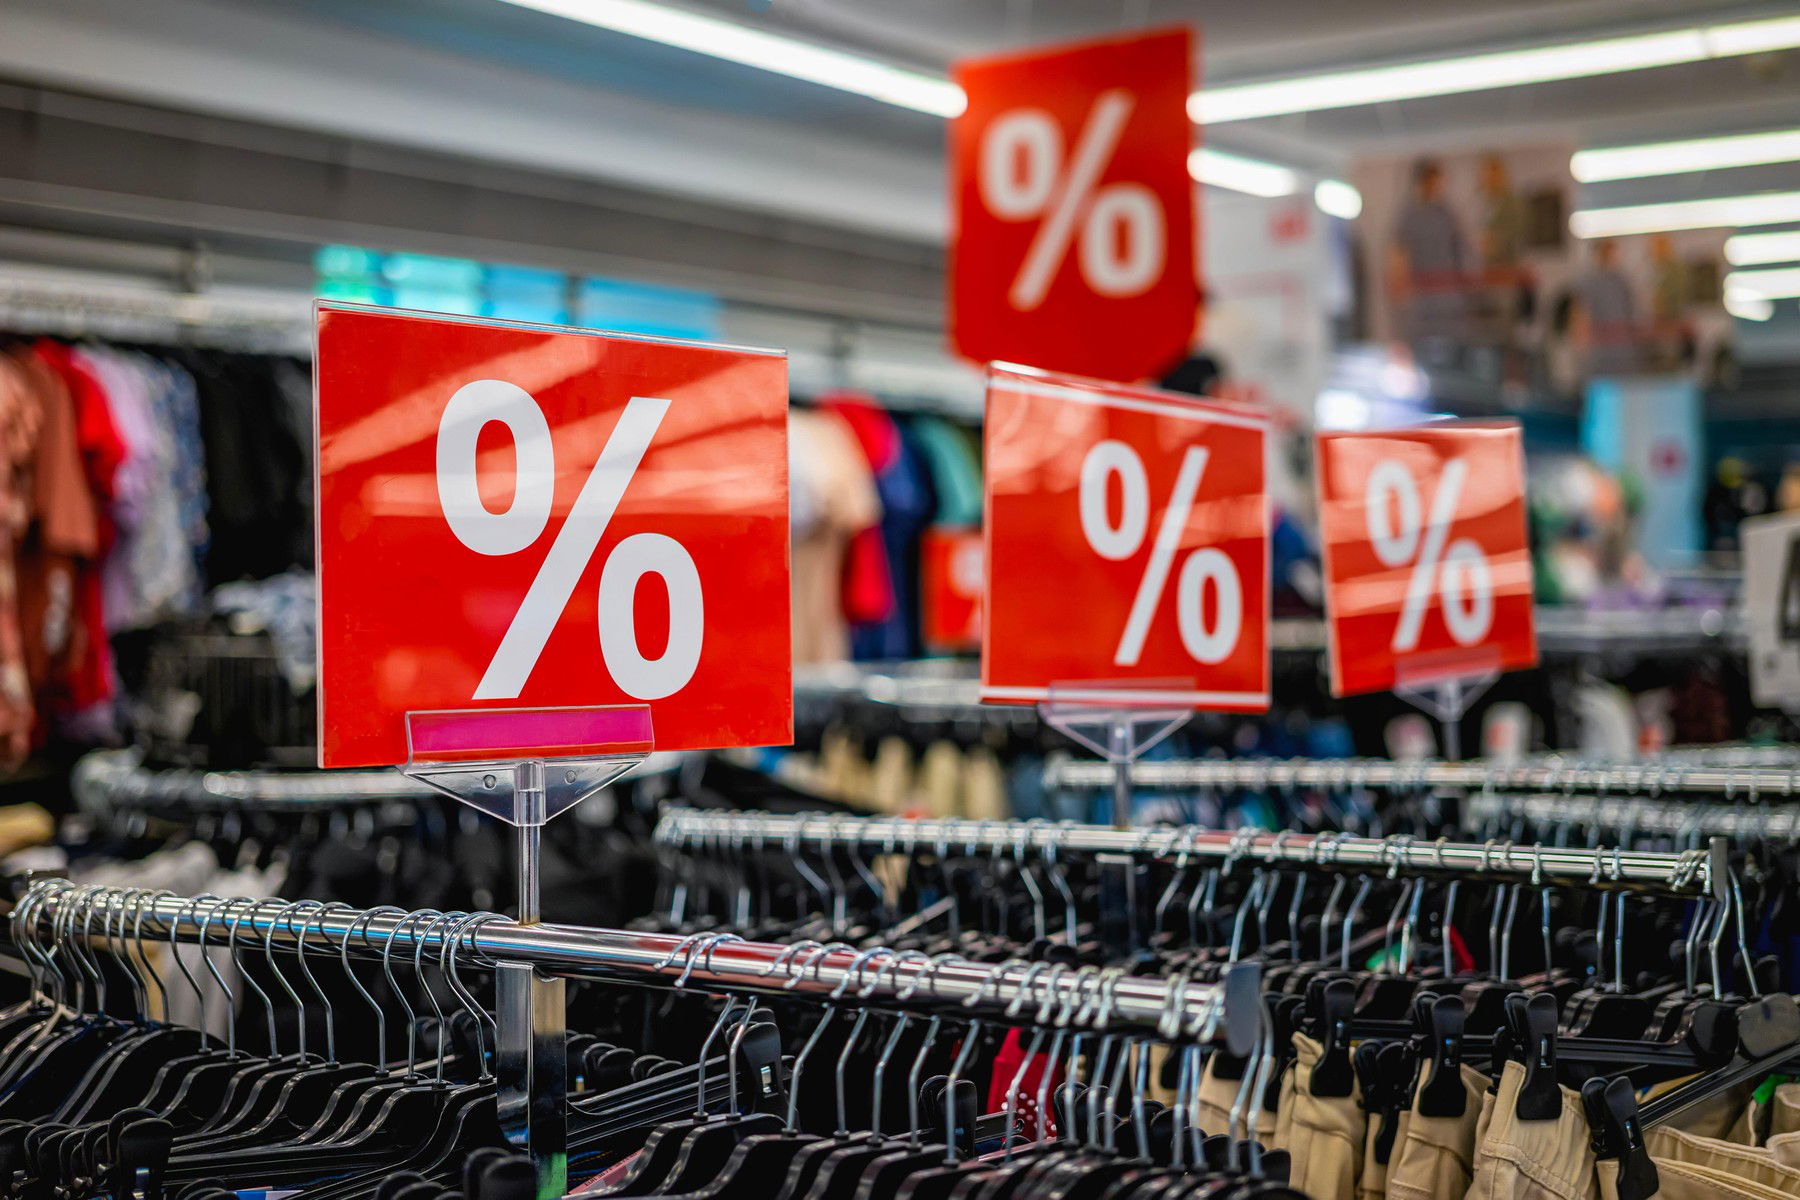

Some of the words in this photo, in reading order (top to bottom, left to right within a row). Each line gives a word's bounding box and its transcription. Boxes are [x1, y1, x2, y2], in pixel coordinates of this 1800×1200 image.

[980, 91, 1166, 310] %
[436, 380, 704, 700] %
[1080, 441, 1240, 666] %
[1366, 458, 1496, 652] %
